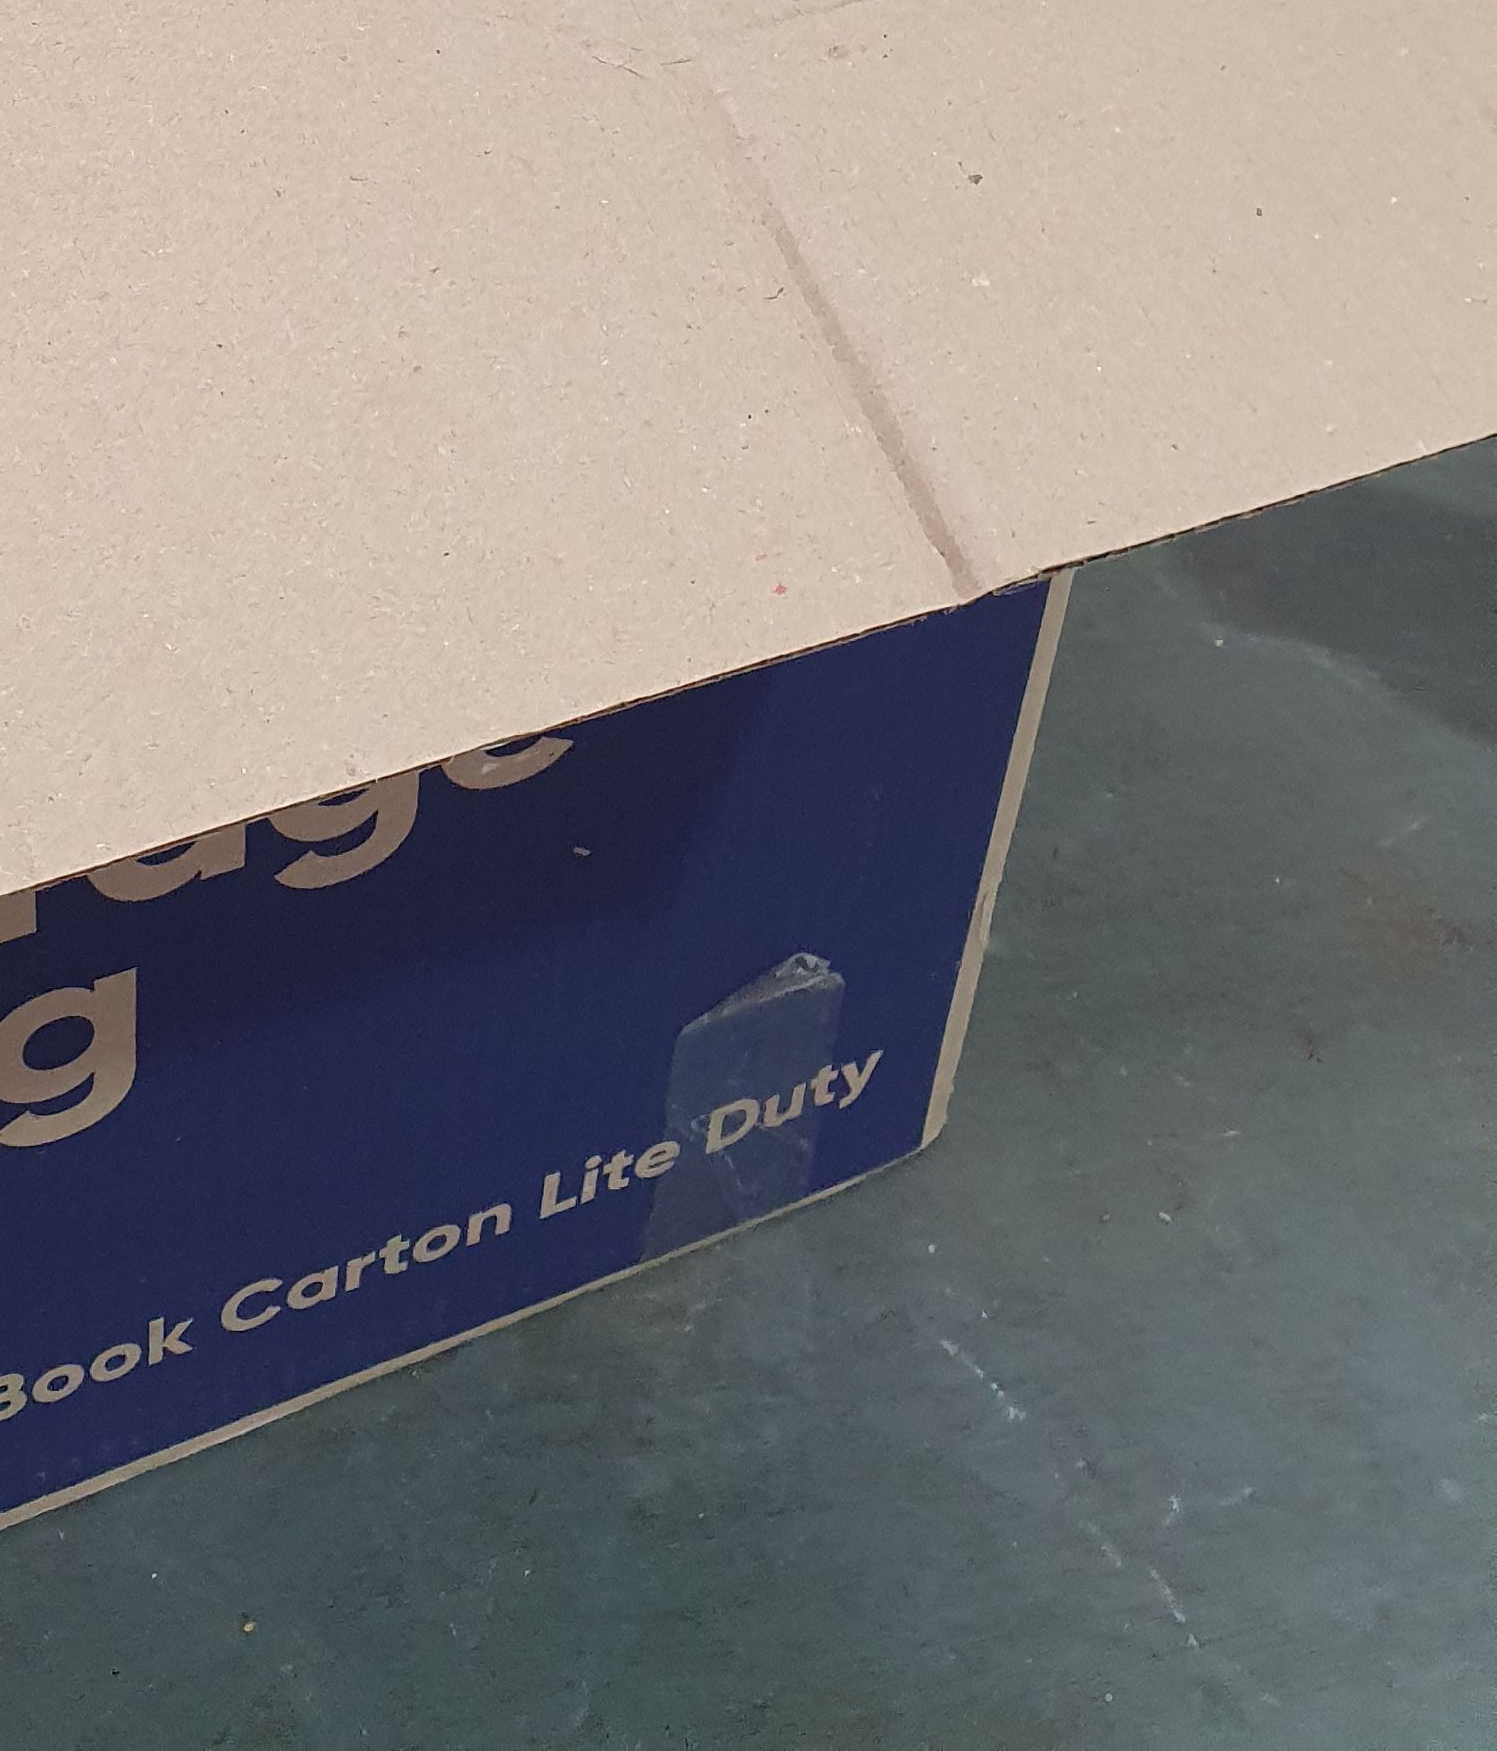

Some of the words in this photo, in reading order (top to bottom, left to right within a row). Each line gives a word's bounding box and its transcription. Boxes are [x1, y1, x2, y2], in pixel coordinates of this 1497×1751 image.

[220, 1202, 512, 1333] Carton
[540, 1139, 681, 1220] Lite
[705, 1049, 884, 1154] Duty
